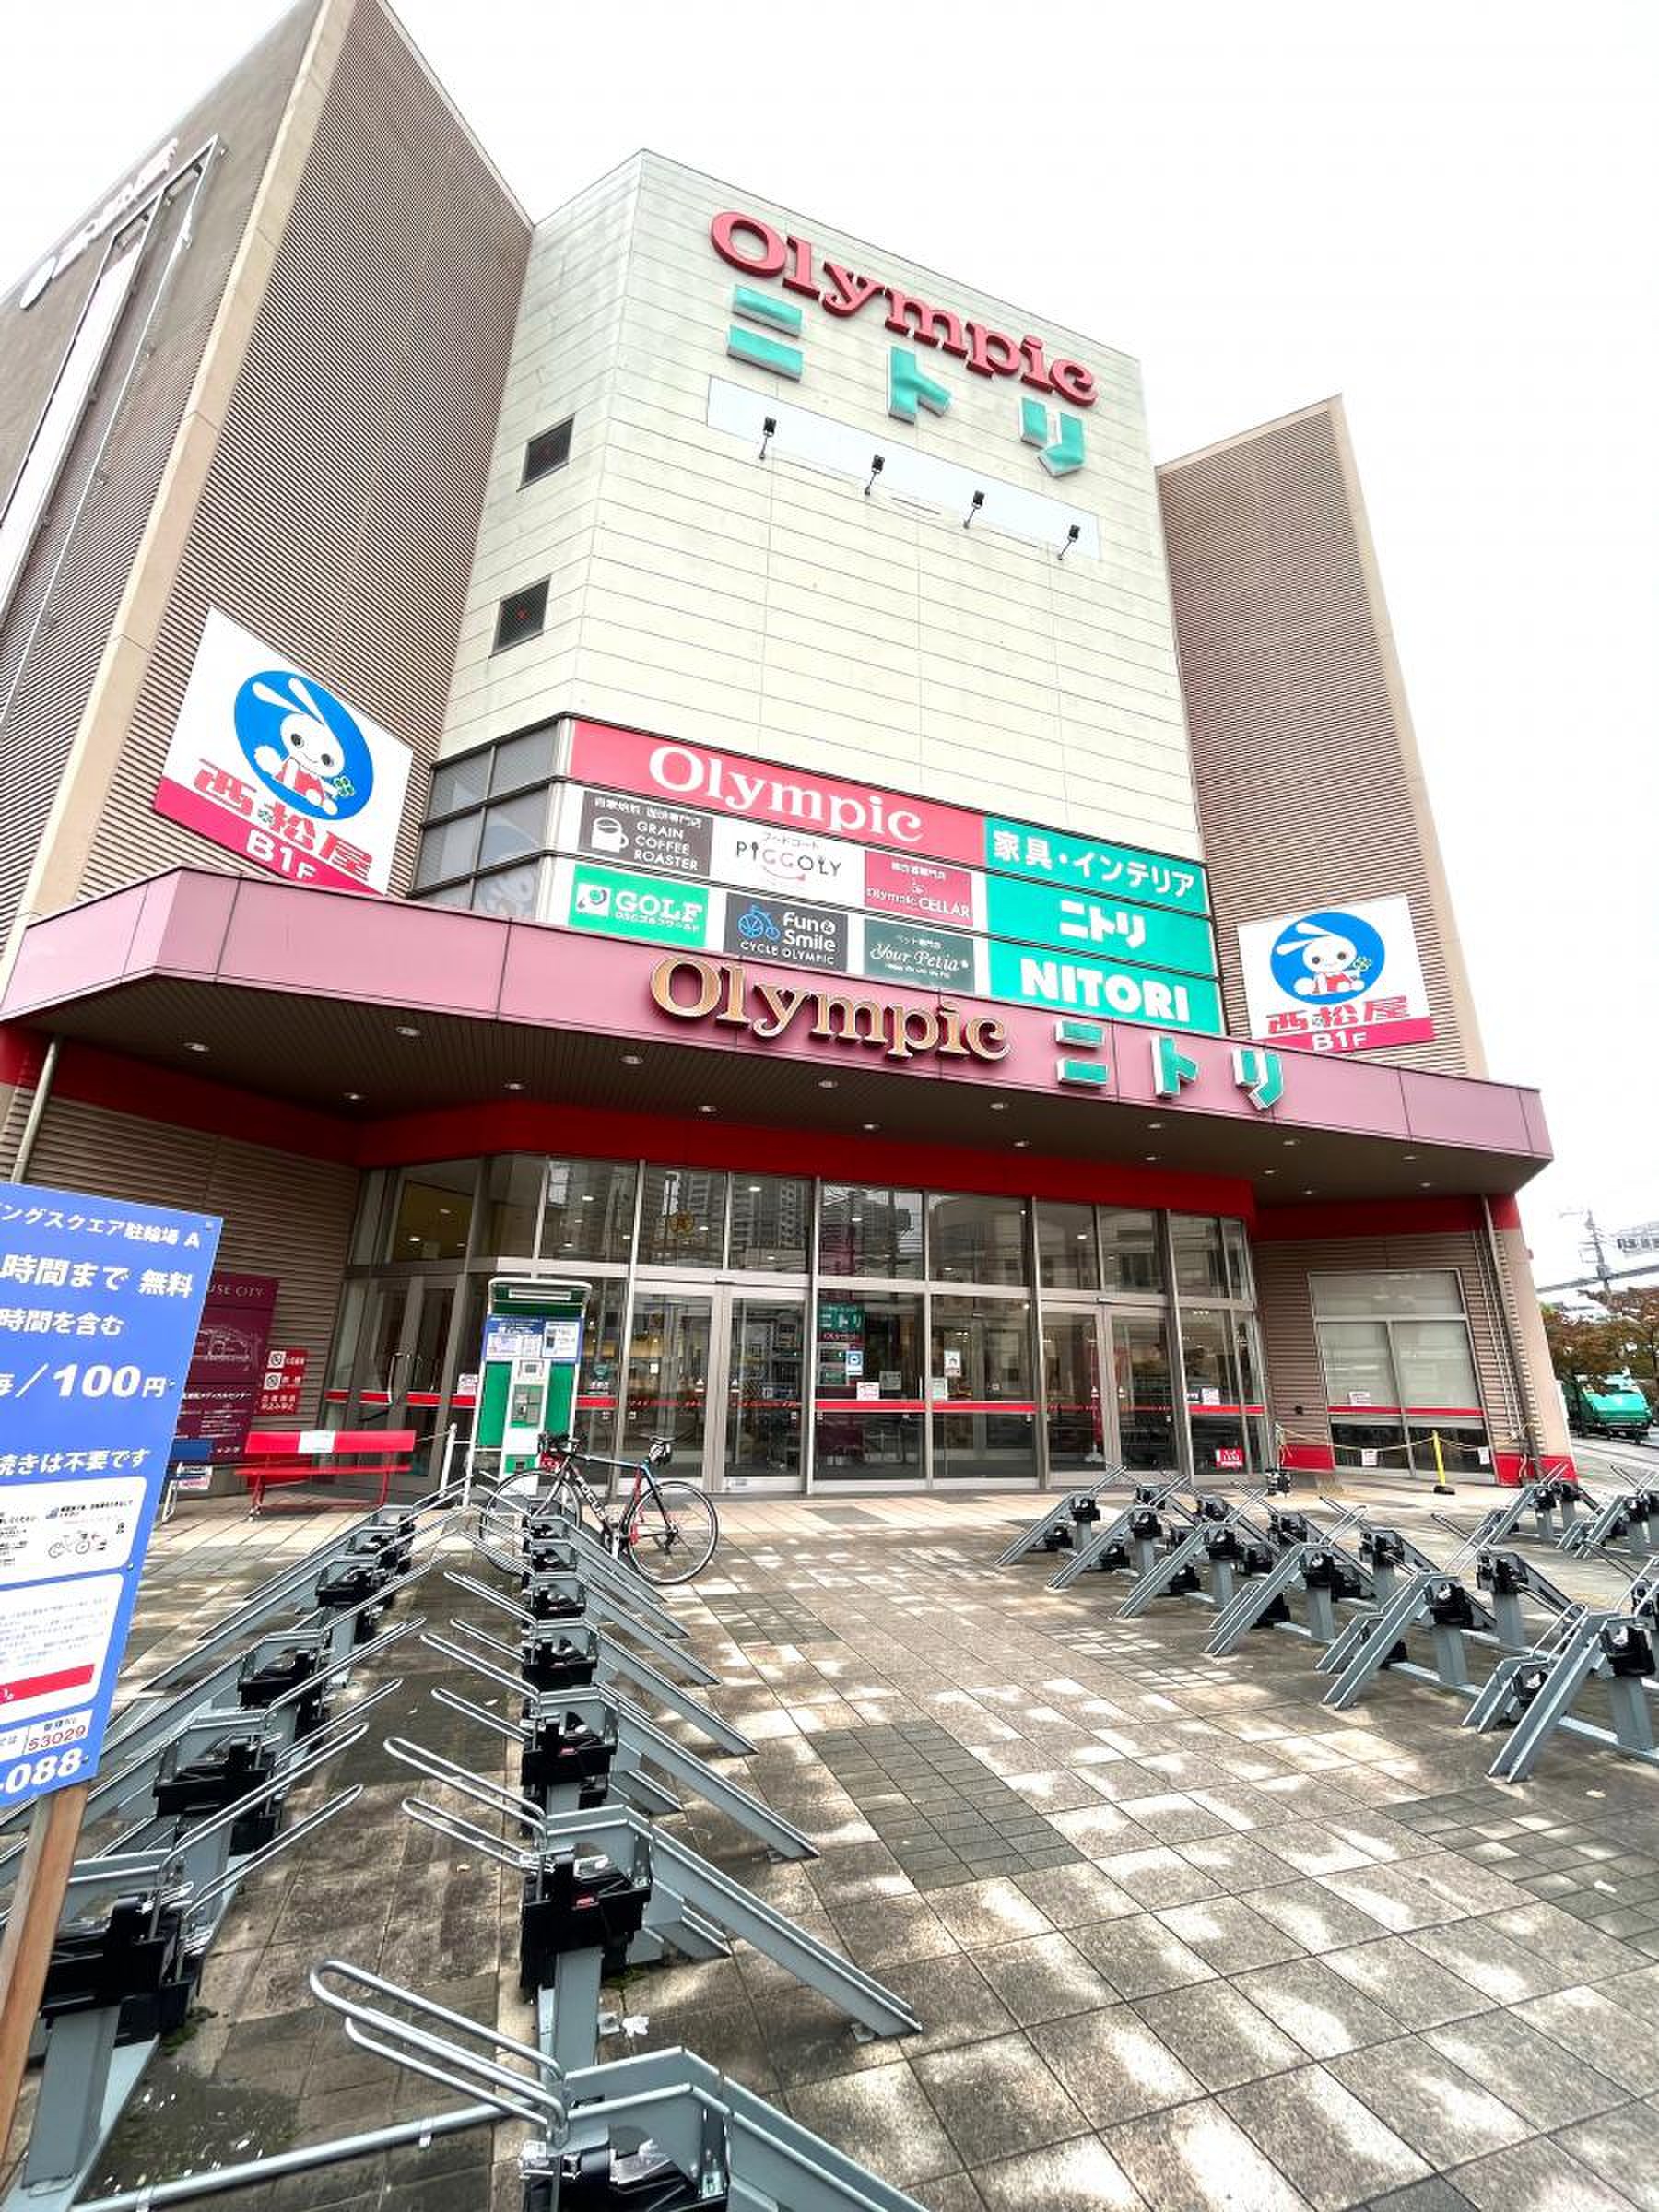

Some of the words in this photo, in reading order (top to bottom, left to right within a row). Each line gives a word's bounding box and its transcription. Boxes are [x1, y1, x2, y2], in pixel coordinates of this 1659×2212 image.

[709, 210, 1098, 406] Olympic
[726, 283, 1086, 477] ニトリ
[649, 747, 922, 842] Olympic
[192, 758, 373, 882] 西松屋
[636, 820, 684, 840] GRAIN
[246, 830, 317, 879] B1F
[633, 849, 699, 871] ROASTER
[635, 834, 690, 855] COFFEE
[993, 830, 1195, 898] 家具・インテリア
[615, 890, 703, 923] GOLF
[919, 897, 971, 918] CELLAR
[1060, 899, 1146, 948] ニトリ
[740, 941, 779, 956] CYCLE
[781, 947, 834, 965] OLYMPIC
[782, 929, 836, 952] Smile
[869, 943, 912, 962] Your
[649, 955, 1010, 1063] Olympic
[1019, 958, 1191, 1023] NITORI
[1265, 995, 1410, 1034] 西松屋
[1311, 1031, 1368, 1052] B1F
[1054, 1018, 1285, 1110] ニトリ
[183, 1231, 200, 1249] A
[0, 1254, 130, 1291] 時間まで
[138, 1268, 193, 1298] 無料
[0, 1307, 124, 1336] 時間を含む
